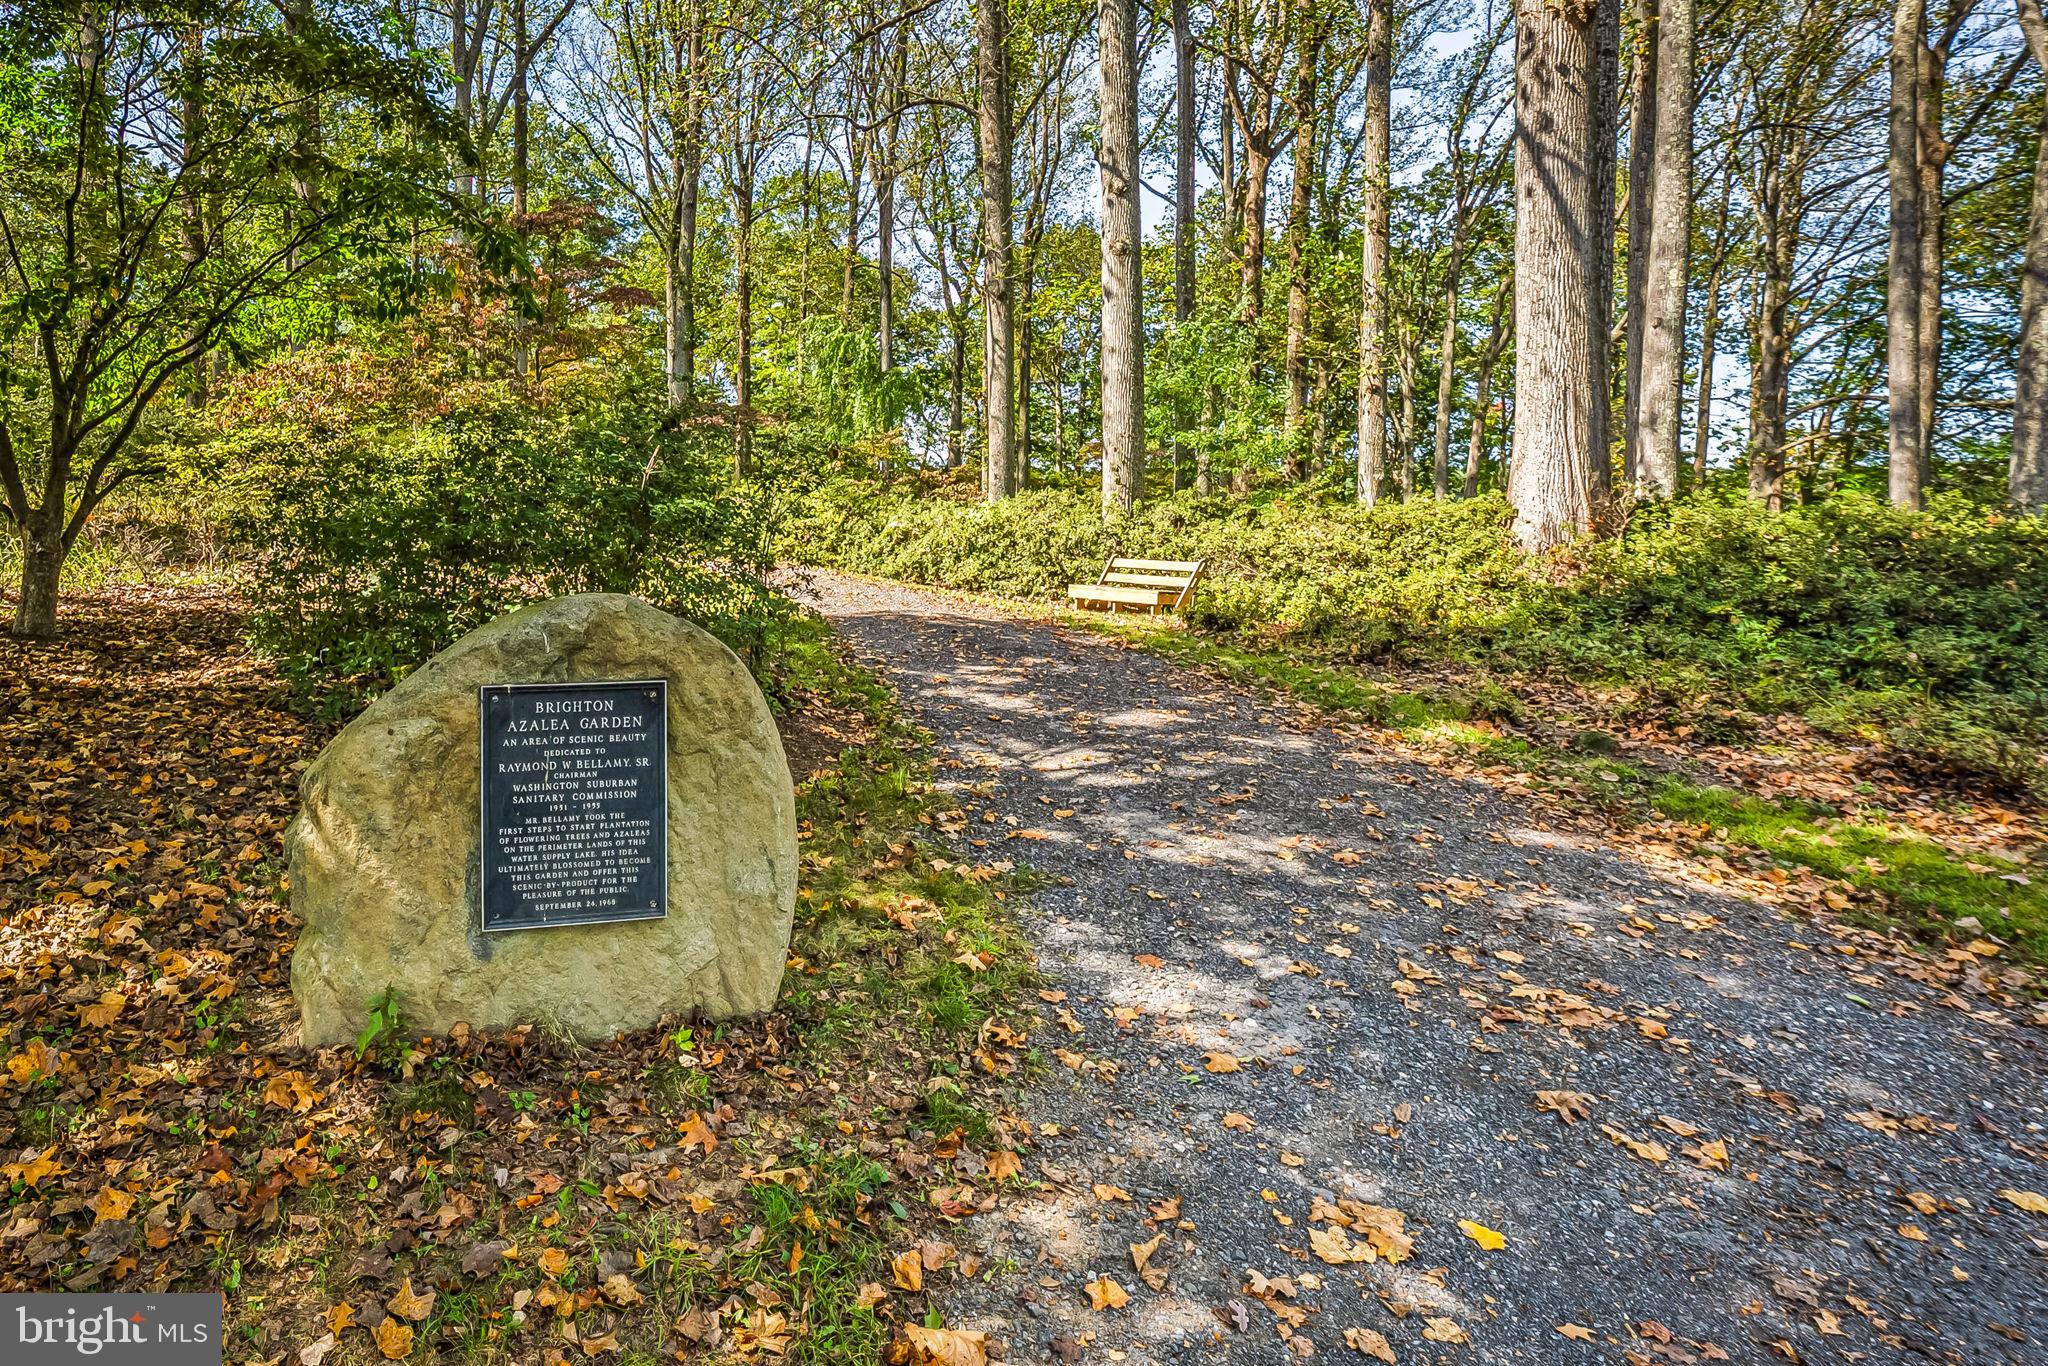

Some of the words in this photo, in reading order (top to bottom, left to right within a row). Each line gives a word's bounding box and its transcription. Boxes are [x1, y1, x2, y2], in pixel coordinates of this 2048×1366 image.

[535, 700, 614, 713] BRIGHTON
[507, 719, 570, 732] AZALEA
[580, 716, 642, 729] GARDEN
[503, 739, 517, 747] AN
[522, 738, 548, 746] AREA
[569, 735, 603, 743] SCENIC
[609, 733, 647, 742] BEAUTY
[544, 748, 591, 757] DEDICATED
[499, 762, 557, 773] RAYMOND
[554, 771, 598, 779] CHAIRMAN
[513, 782, 579, 792] WASHINGTON
[587, 779, 638, 788] SUBURBAN
[513, 794, 565, 804] SANITARY
[572, 790, 637, 800] COMMISSION
[550, 803, 567, 812] 1951
[542, 815, 580, 823] BELLAMY
[570, 823, 595, 831] START
[600, 820, 650, 829] PLANTATION
[514, 834, 560, 844] FLOWERING
[614, 829, 650, 837] AZALEAS
[538, 842, 583, 851] PERIMETER
[628, 838, 646, 846] THIS
[511, 854, 538, 862] WATER
[542, 852, 570, 861] SUPPLY
[498, 863, 548, 873] ULTIMATELY
[552, 860, 601, 870] BLOSSOMED
[618, 856, 650, 865] BECOME
[511, 874, 531, 882] THIS
[535, 871, 568, 880] GARDEN
[592, 868, 618, 876] OFFER
[621, 866, 639, 874] THIS
[522, 891, 562, 900] PLEASURE
[535, 902, 582, 912] SEPTEMBER
